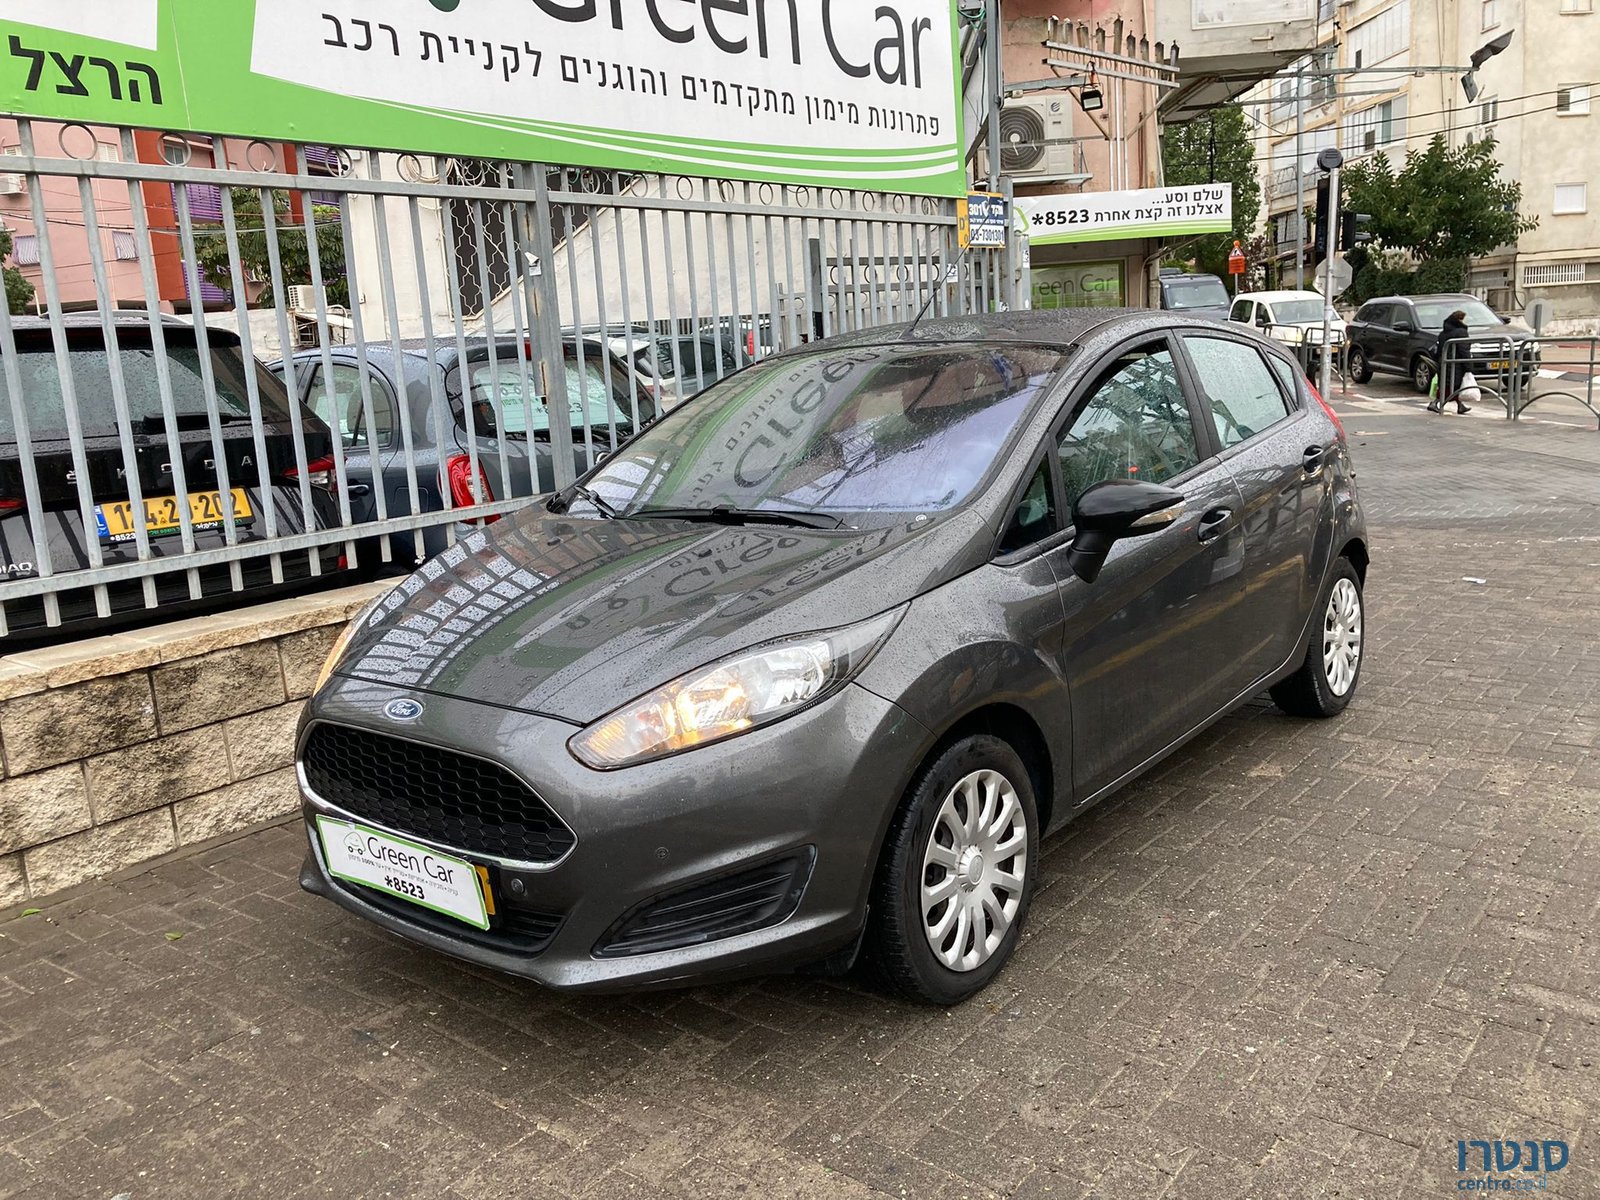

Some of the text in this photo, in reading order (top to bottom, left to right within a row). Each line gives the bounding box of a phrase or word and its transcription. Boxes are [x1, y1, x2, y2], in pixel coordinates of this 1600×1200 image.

[322, 13, 399, 56] רכב
[822, 0, 931, 88] Car
[8, 35, 163, 105] הרצל
[419, 30, 542, 82] לקניית
[560, 55, 668, 96] והוגנים
[683, 75, 795, 116] מתקדמים
[804, 95, 859, 124] מימון
[868, 106, 939, 136] פתרונות
[1193, 188, 1223, 201] שלם
[1094, 209, 1130, 222] אחרת
[1135, 207, 1162, 222] קצת
[1167, 205, 1181, 216] זה
[1187, 202, 1223, 217] אצלנו
[1032, 273, 1114, 297] reen Car
[390, 701, 416, 716] Ford
[367, 836, 420, 873] Green
[423, 855, 454, 885] Car
